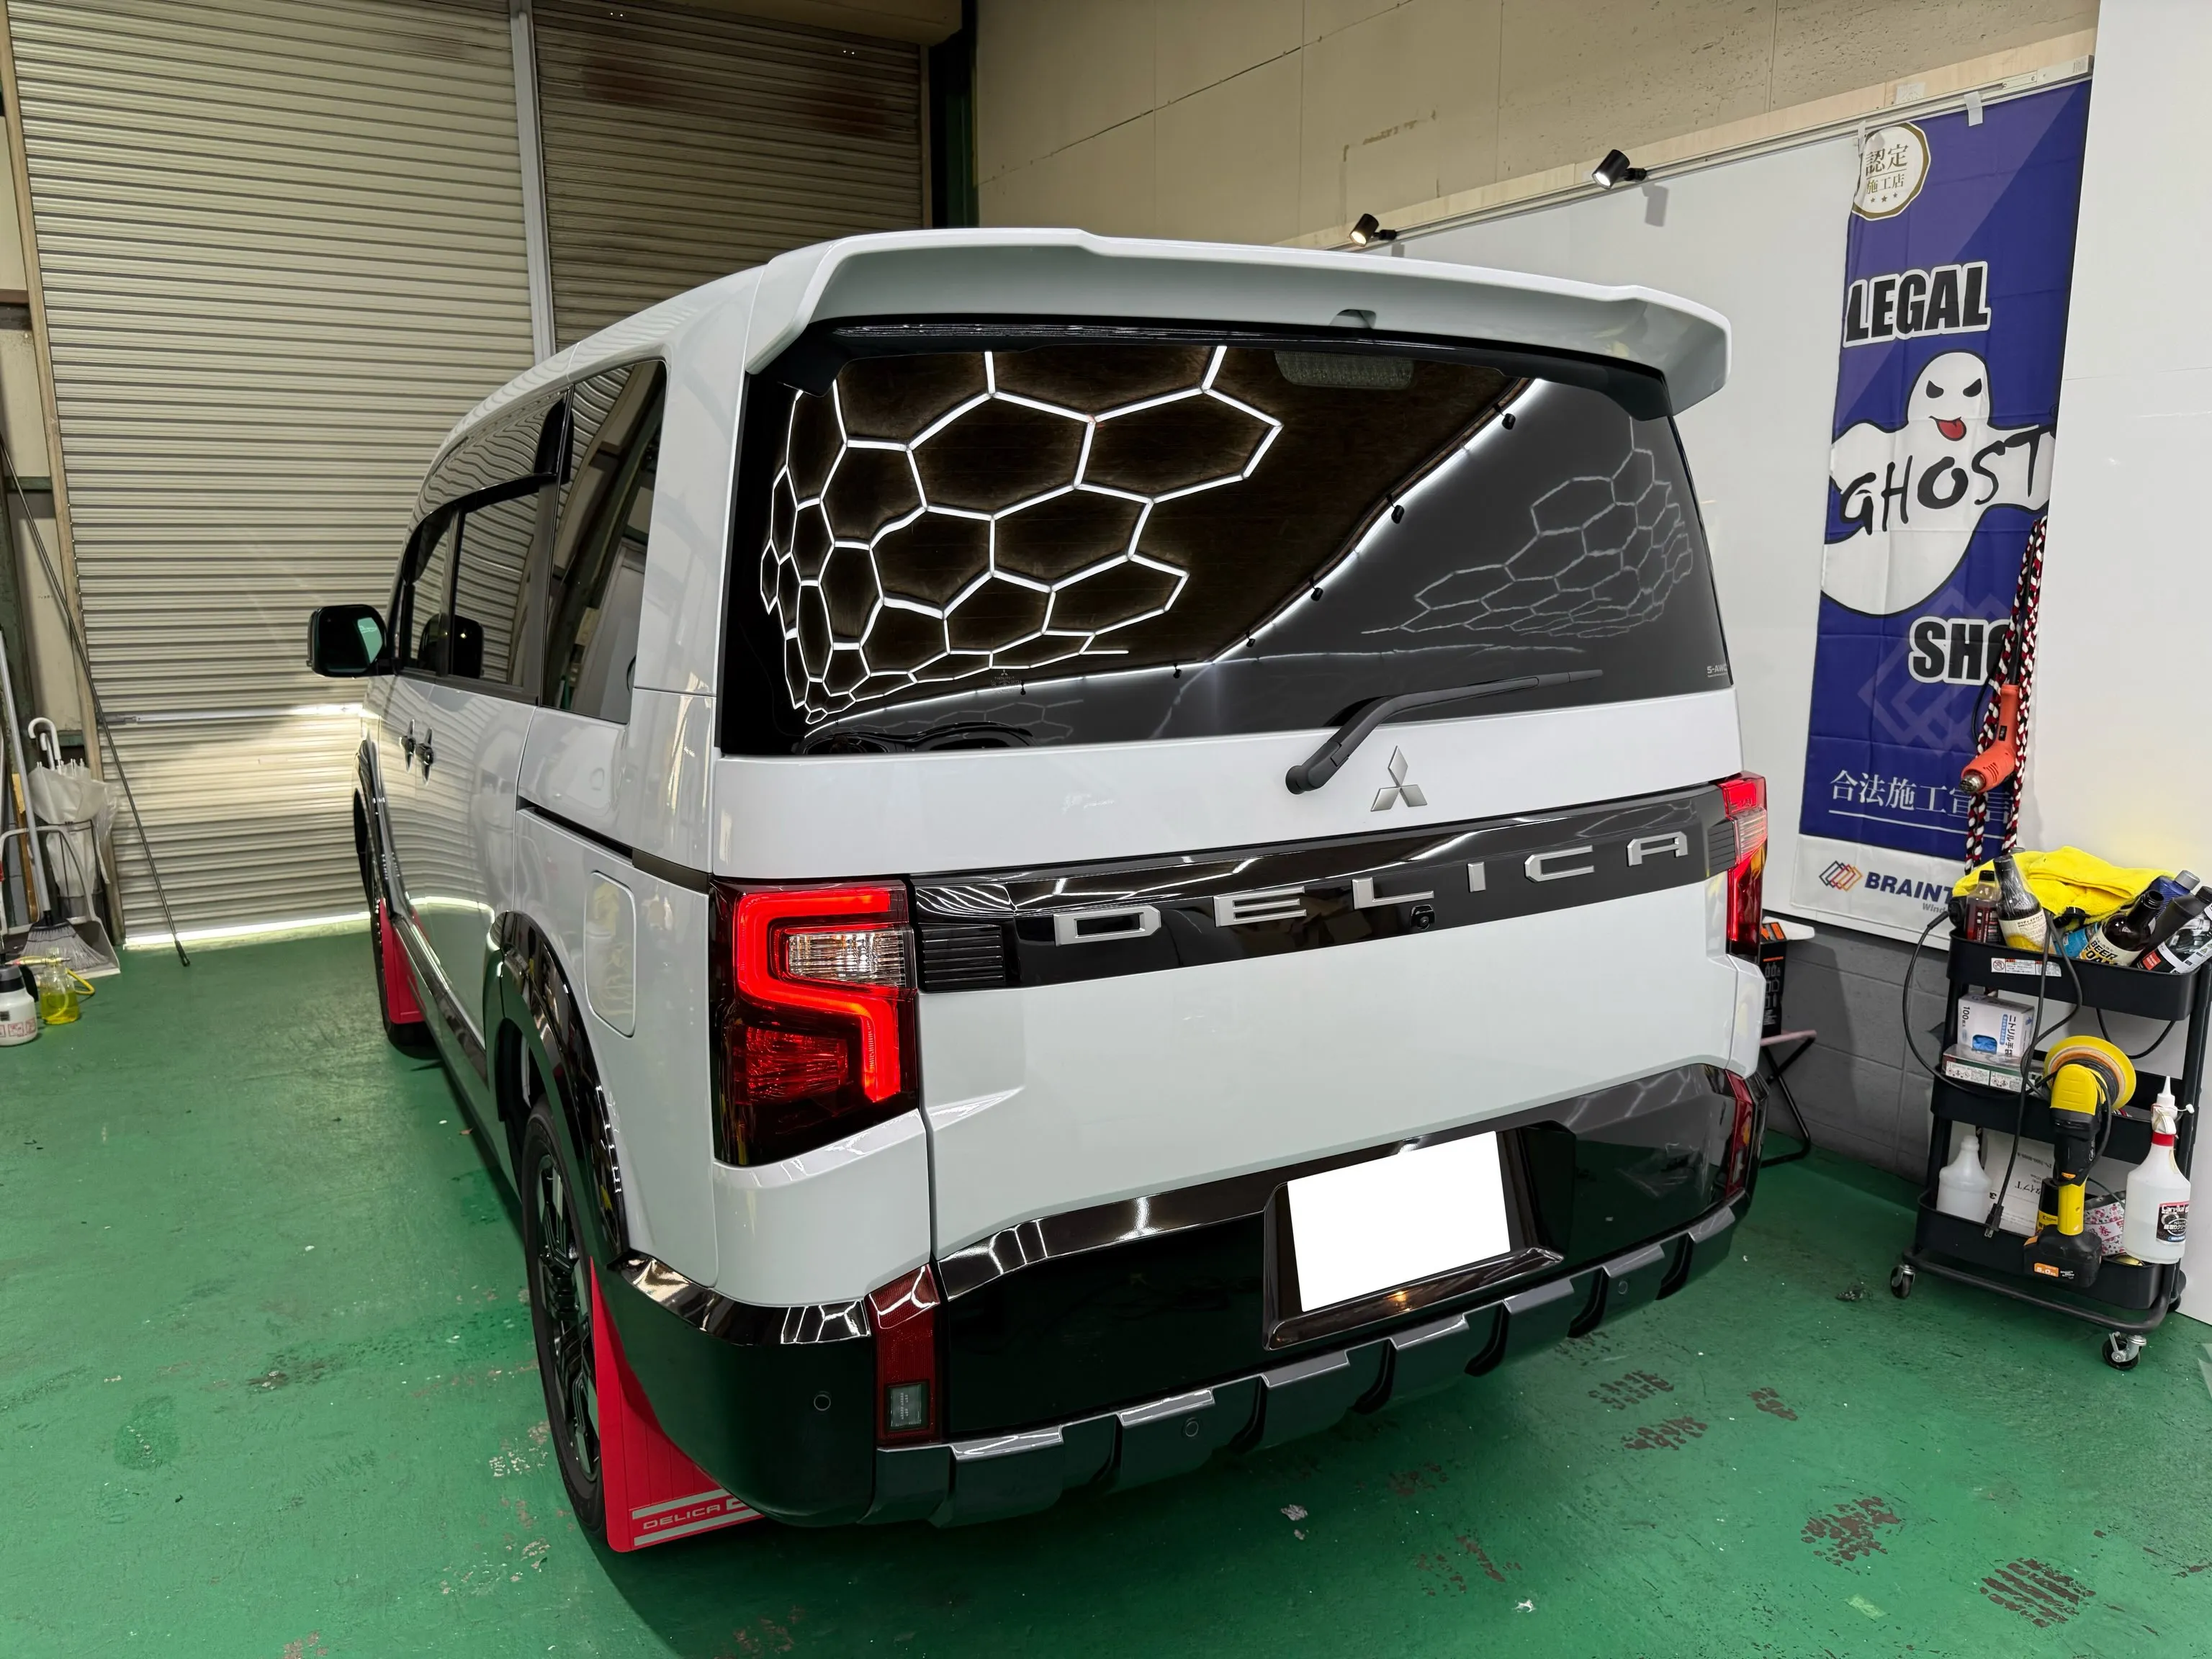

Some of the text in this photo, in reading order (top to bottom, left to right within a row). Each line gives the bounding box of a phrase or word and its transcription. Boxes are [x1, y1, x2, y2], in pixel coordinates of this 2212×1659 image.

[1866, 144, 1908, 176] 認定
[1866, 174, 1905, 194] 施工店
[1844, 262, 1991, 347] LEGAL
[1840, 424, 2056, 535] GHOST
[1054, 831, 1688, 945] DELICA
[2091, 940, 2118, 960] BEER
[643, 1504, 721, 1529] DELICA
